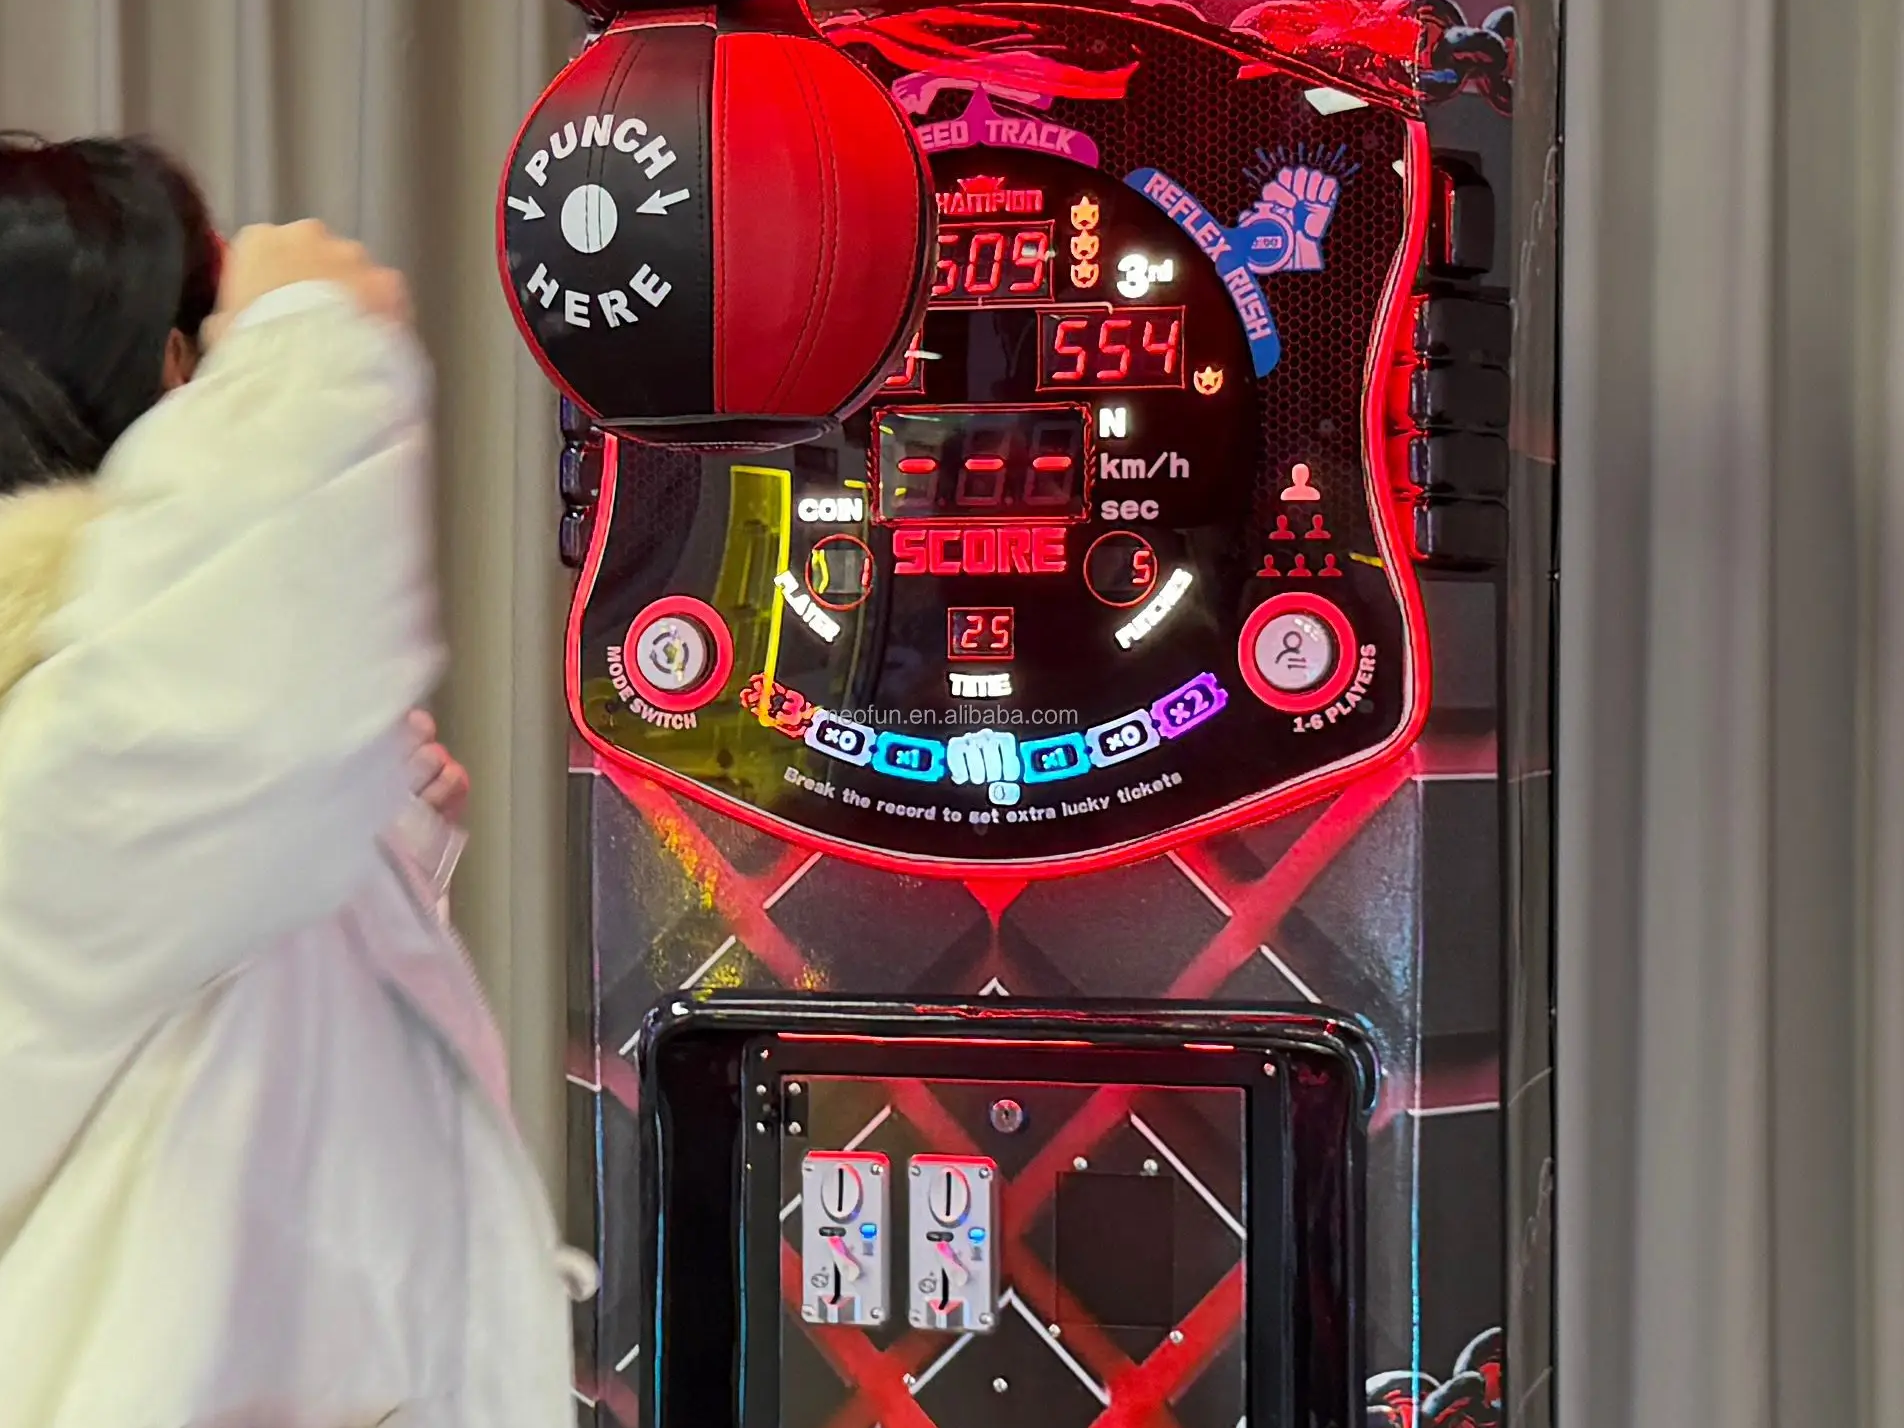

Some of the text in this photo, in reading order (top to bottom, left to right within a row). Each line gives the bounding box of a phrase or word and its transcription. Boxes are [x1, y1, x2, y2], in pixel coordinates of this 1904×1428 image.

[524, 114, 677, 186] PUNCH
[918, 119, 1078, 155] EED TRACK
[935, 189, 1043, 214] HAMPION
[1116, 253, 1174, 299] 3rd
[1142, 170, 1273, 343] REFLEX RUSH
[527, 262, 673, 328] HERE
[1051, 319, 1180, 380] 554
[1098, 407, 1127, 438] N
[1100, 452, 1190, 480] km/h
[798, 498, 863, 522] COIN
[1101, 499, 1159, 521] sec
[893, 528, 1067, 574] SCORE
[960, 615, 1010, 648] 25
[607, 646, 697, 730] MODE SWITCH
[949, 672, 1013, 698] TIME
[1293, 644, 1377, 733] 1-6 PLAYERS
[783, 766, 836, 799] Break
[842, 788, 871, 809] the
[876, 800, 936, 821] record
[942, 807, 962, 823] to
[1006, 805, 1056, 823] extra
[1061, 795, 1111, 817] lucky
[1116, 771, 1183, 804] tickets
